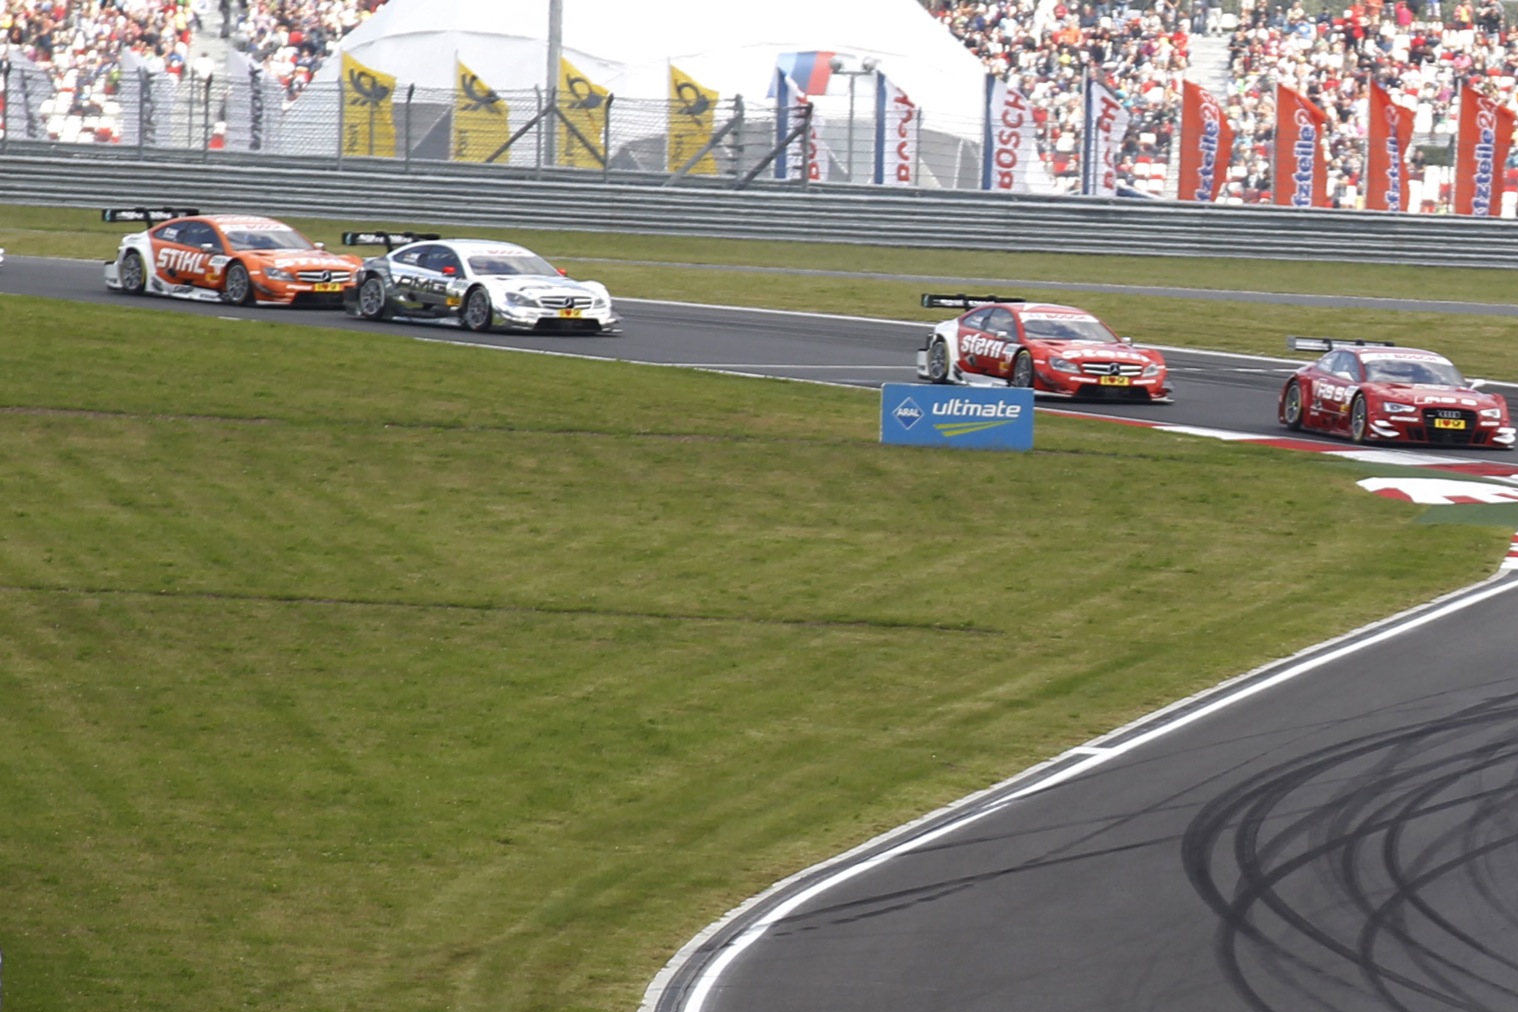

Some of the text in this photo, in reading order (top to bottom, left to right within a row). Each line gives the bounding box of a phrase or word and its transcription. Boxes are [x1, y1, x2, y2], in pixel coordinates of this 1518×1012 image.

[995, 90, 1026, 190] BOSCH
[156, 248, 205, 274] STIHL
[960, 333, 1004, 358] stern
[897, 407, 921, 417] ARAL
[932, 398, 1022, 418] ultimate
